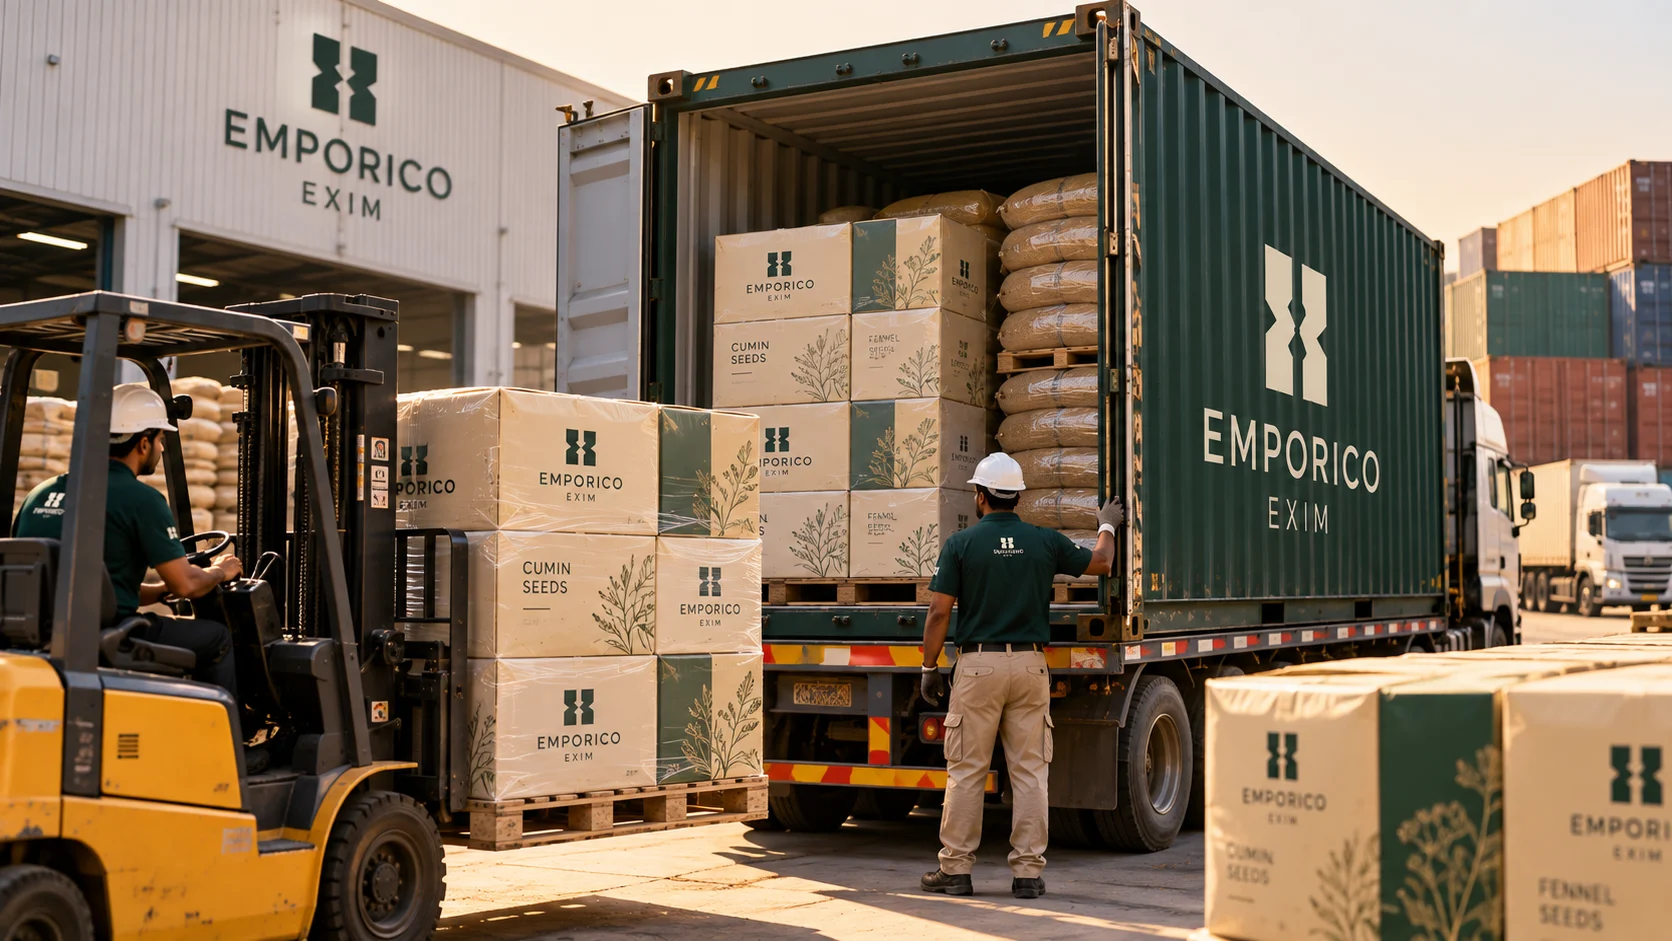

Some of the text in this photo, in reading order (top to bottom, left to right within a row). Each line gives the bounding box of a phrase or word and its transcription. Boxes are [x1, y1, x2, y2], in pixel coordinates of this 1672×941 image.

[224, 108, 453, 201] EMPORICO
[302, 181, 382, 221] EXIM
[746, 279, 815, 294] EMPORICO
[767, 294, 792, 302] EXIM
[731, 341, 770, 352] CUMIN
[731, 353, 767, 365] SEEDS
[1203, 407, 1380, 494] EMPORICO
[759, 456, 812, 467] PORICO
[539, 472, 623, 491] EMPORICO
[765, 469, 789, 477] EXIM
[396, 479, 456, 496] PORICO
[566, 492, 597, 503] EXIM
[1268, 496, 1329, 534] EXIM
[522, 561, 571, 576] CUMIN
[522, 580, 568, 594] SEEDS
[680, 603, 741, 616] EMPORICO
[699, 619, 722, 627] EXIM
[537, 731, 622, 751] EMPORICO
[564, 752, 594, 763] EXIM
[1242, 787, 1327, 812] EMPORICO
[1268, 813, 1298, 826] EXIM
[1570, 813, 1672, 842] EMPORI
[1226, 842, 1274, 866] CUMIN
[1612, 845, 1663, 863] EXIM
[1226, 864, 1270, 886] SEEDS
[1538, 876, 1617, 907] FENNEL
[1538, 903, 1604, 933] SEEDS
